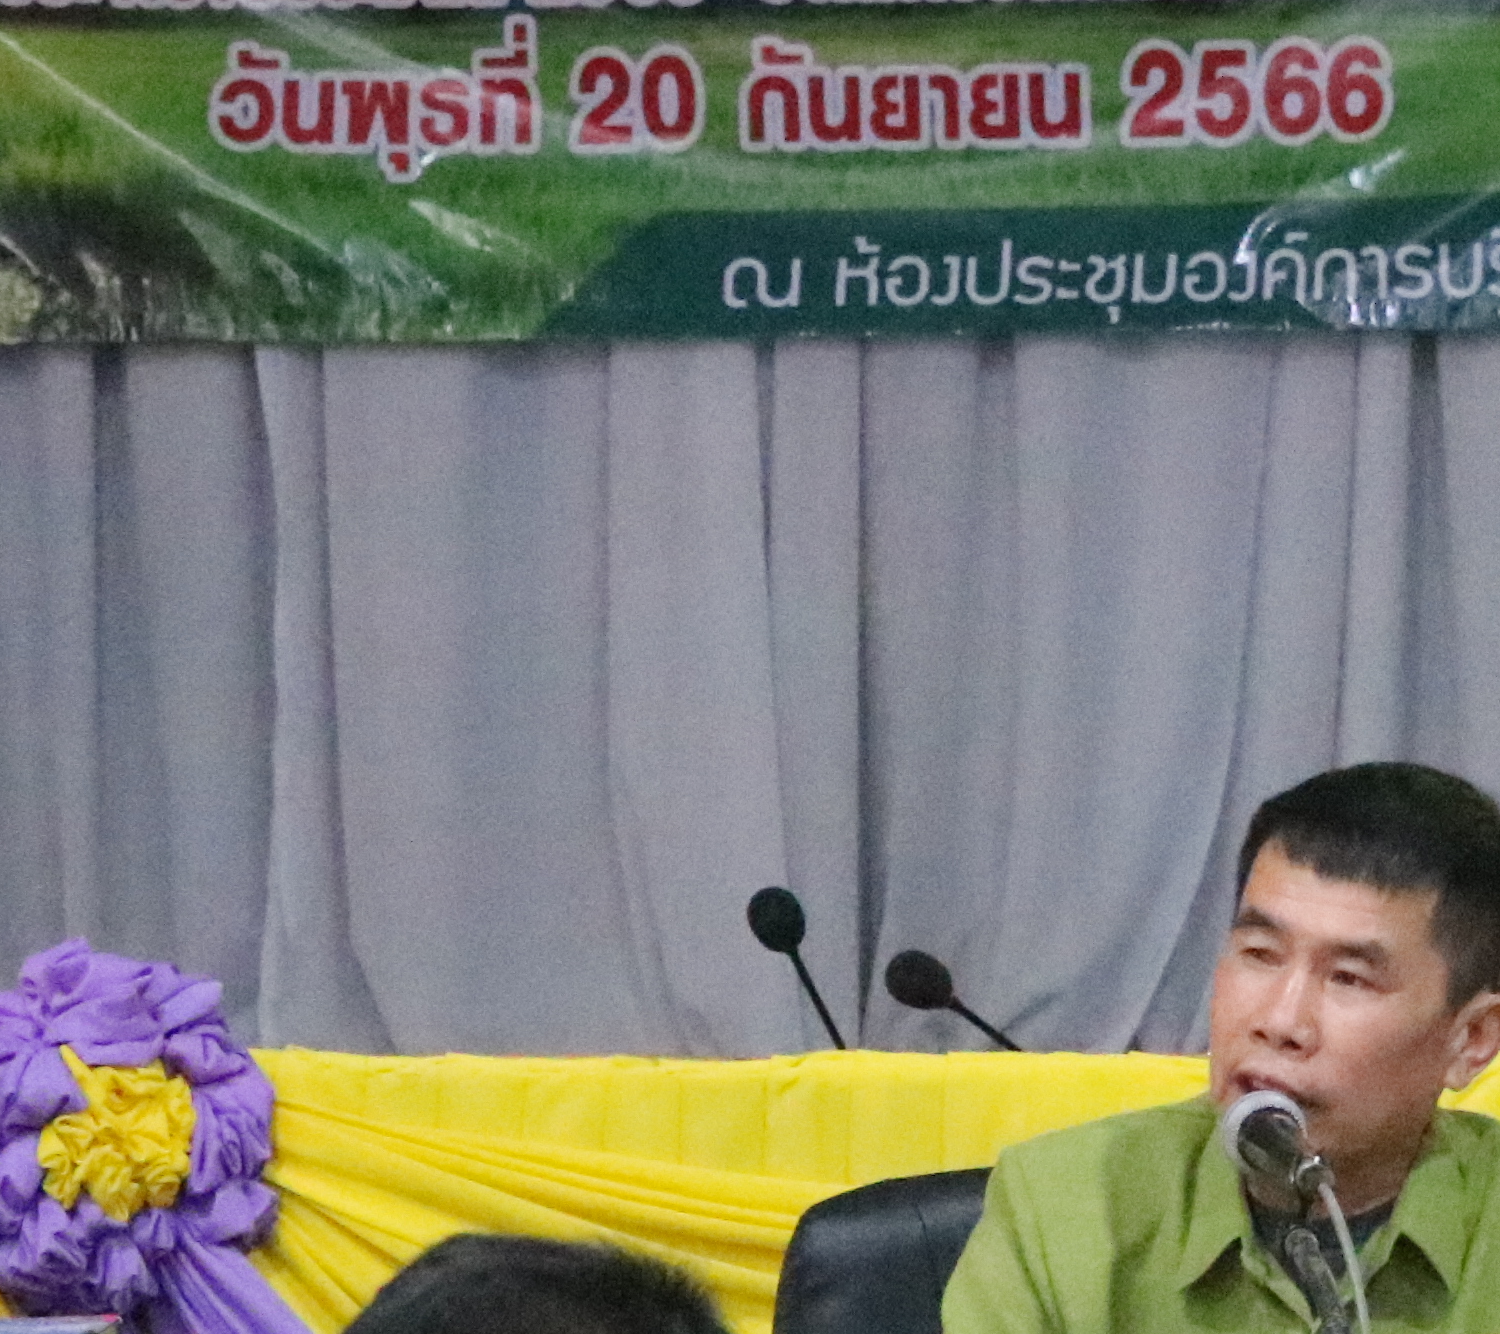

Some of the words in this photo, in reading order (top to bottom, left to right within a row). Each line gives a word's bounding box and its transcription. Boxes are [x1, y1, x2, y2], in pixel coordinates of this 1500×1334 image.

[218, 23, 533, 173] วันพุธที่
[577, 53, 698, 147] 20
[746, 47, 1086, 145] กันยายน
[1126, 45, 1387, 141] 2566
[723, 255, 802, 309] ณ
